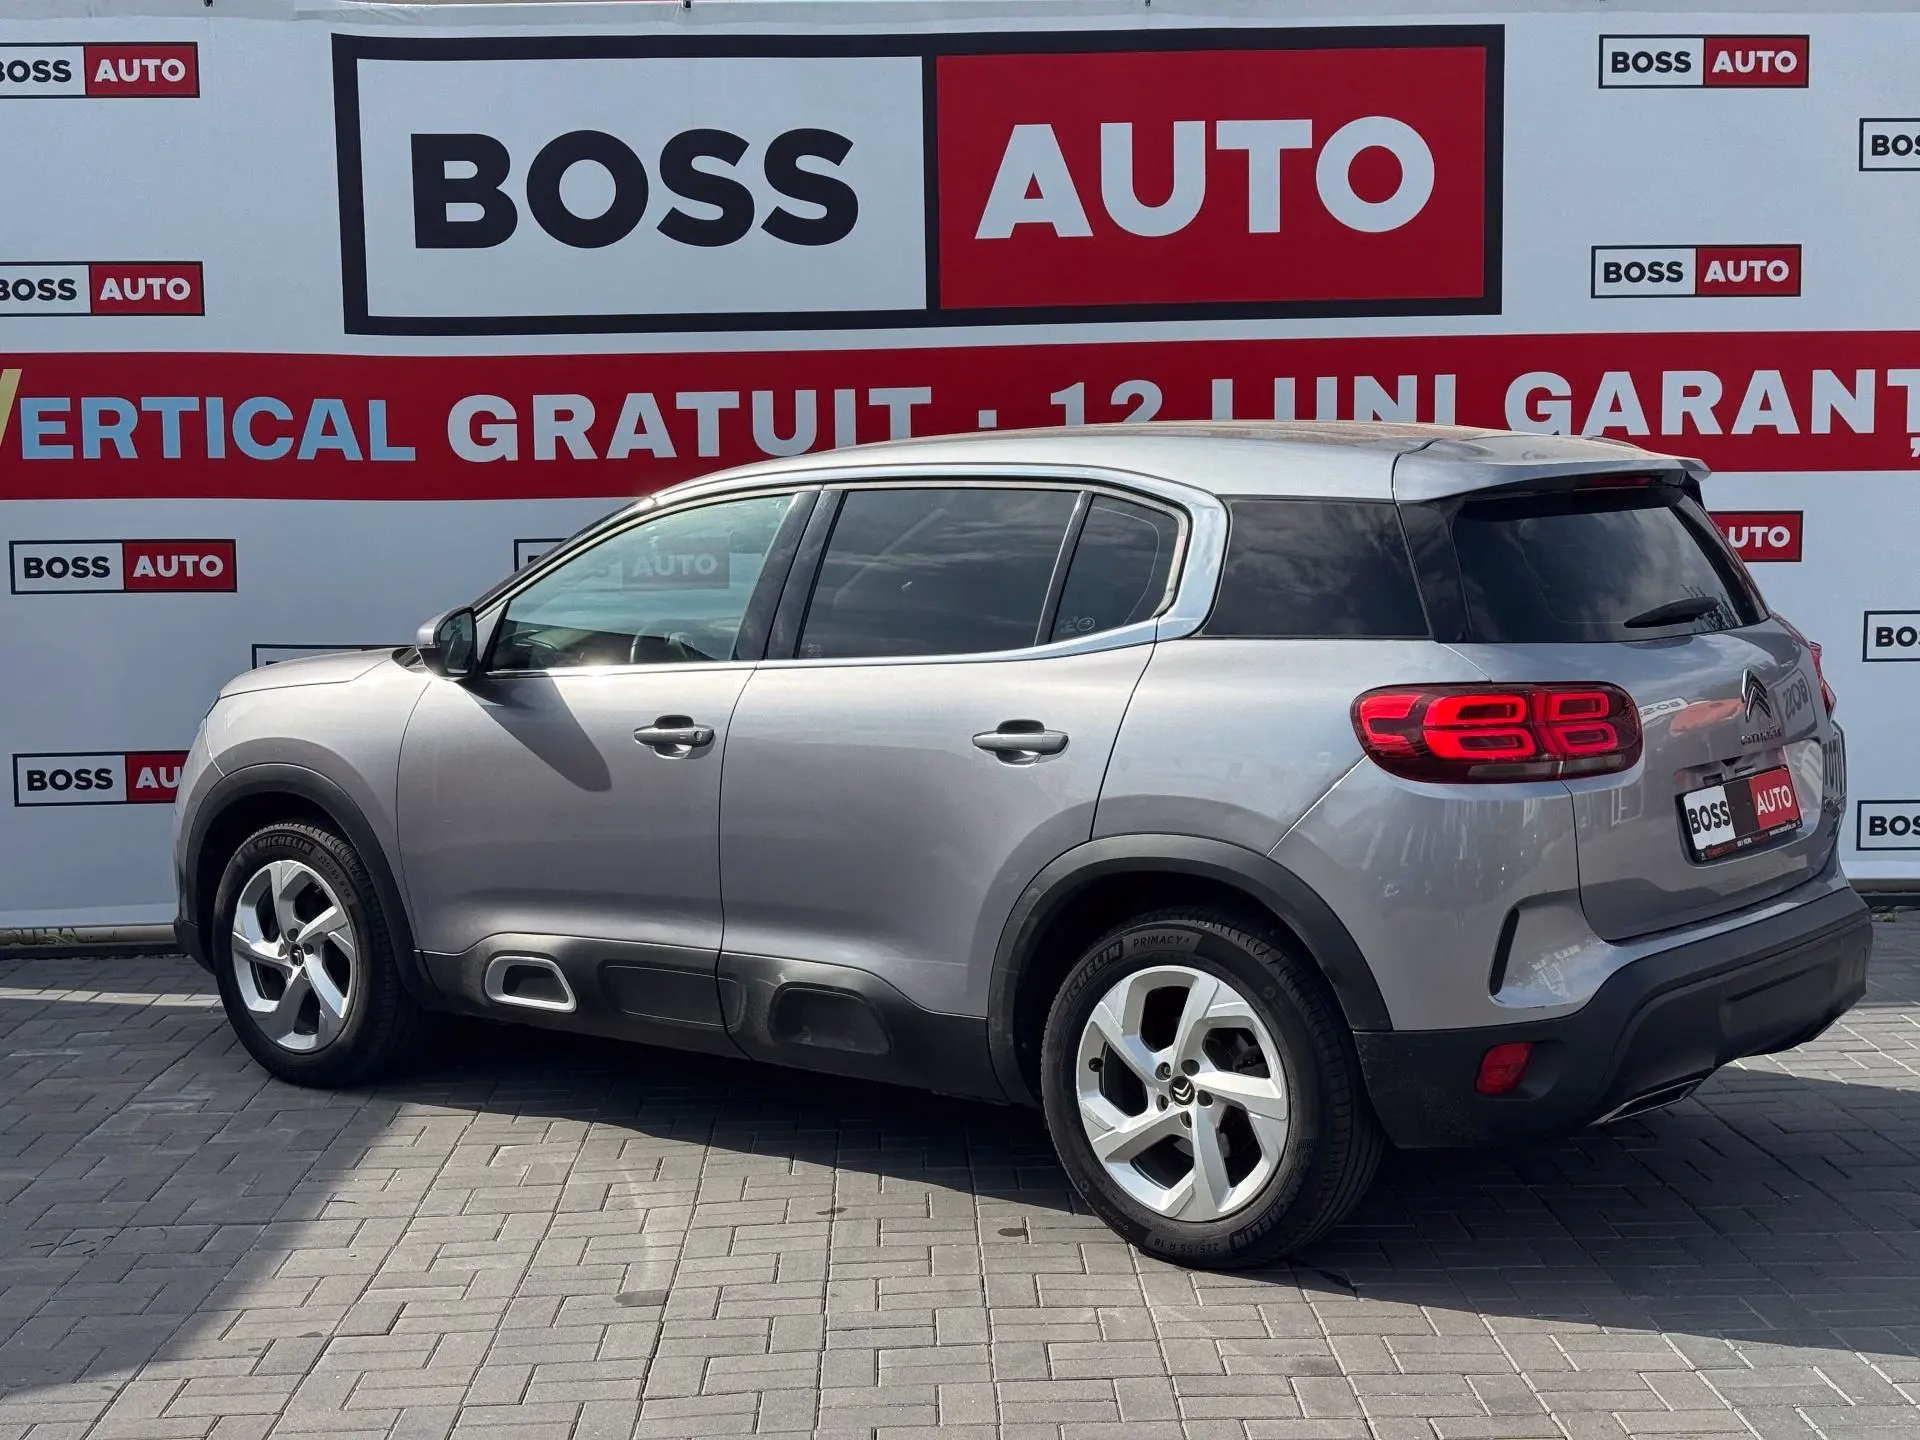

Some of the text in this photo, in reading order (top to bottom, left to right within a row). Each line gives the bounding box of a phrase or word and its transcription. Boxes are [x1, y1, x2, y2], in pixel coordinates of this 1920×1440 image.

[0, 58, 186, 83] OSS AUTO
[1611, 50, 1797, 74] BOSS AUTO
[411, 115, 1436, 249] BOSS AUTO
[1603, 259, 1789, 284] BOSS AUTO
[100, 277, 191, 301] AUTO
[447, 386, 932, 463] GRATUIT
[1050, 379, 1163, 426] 12
[24, 554, 224, 579] BOSS AUTO
[632, 552, 718, 578] AUTO
[1876, 626, 1920, 647] BO
[27, 768, 114, 792] BOSS
[1688, 800, 1731, 835] BOSS
[1757, 785, 1793, 816] AUTO
[257, 835, 314, 854] MICHELIN
